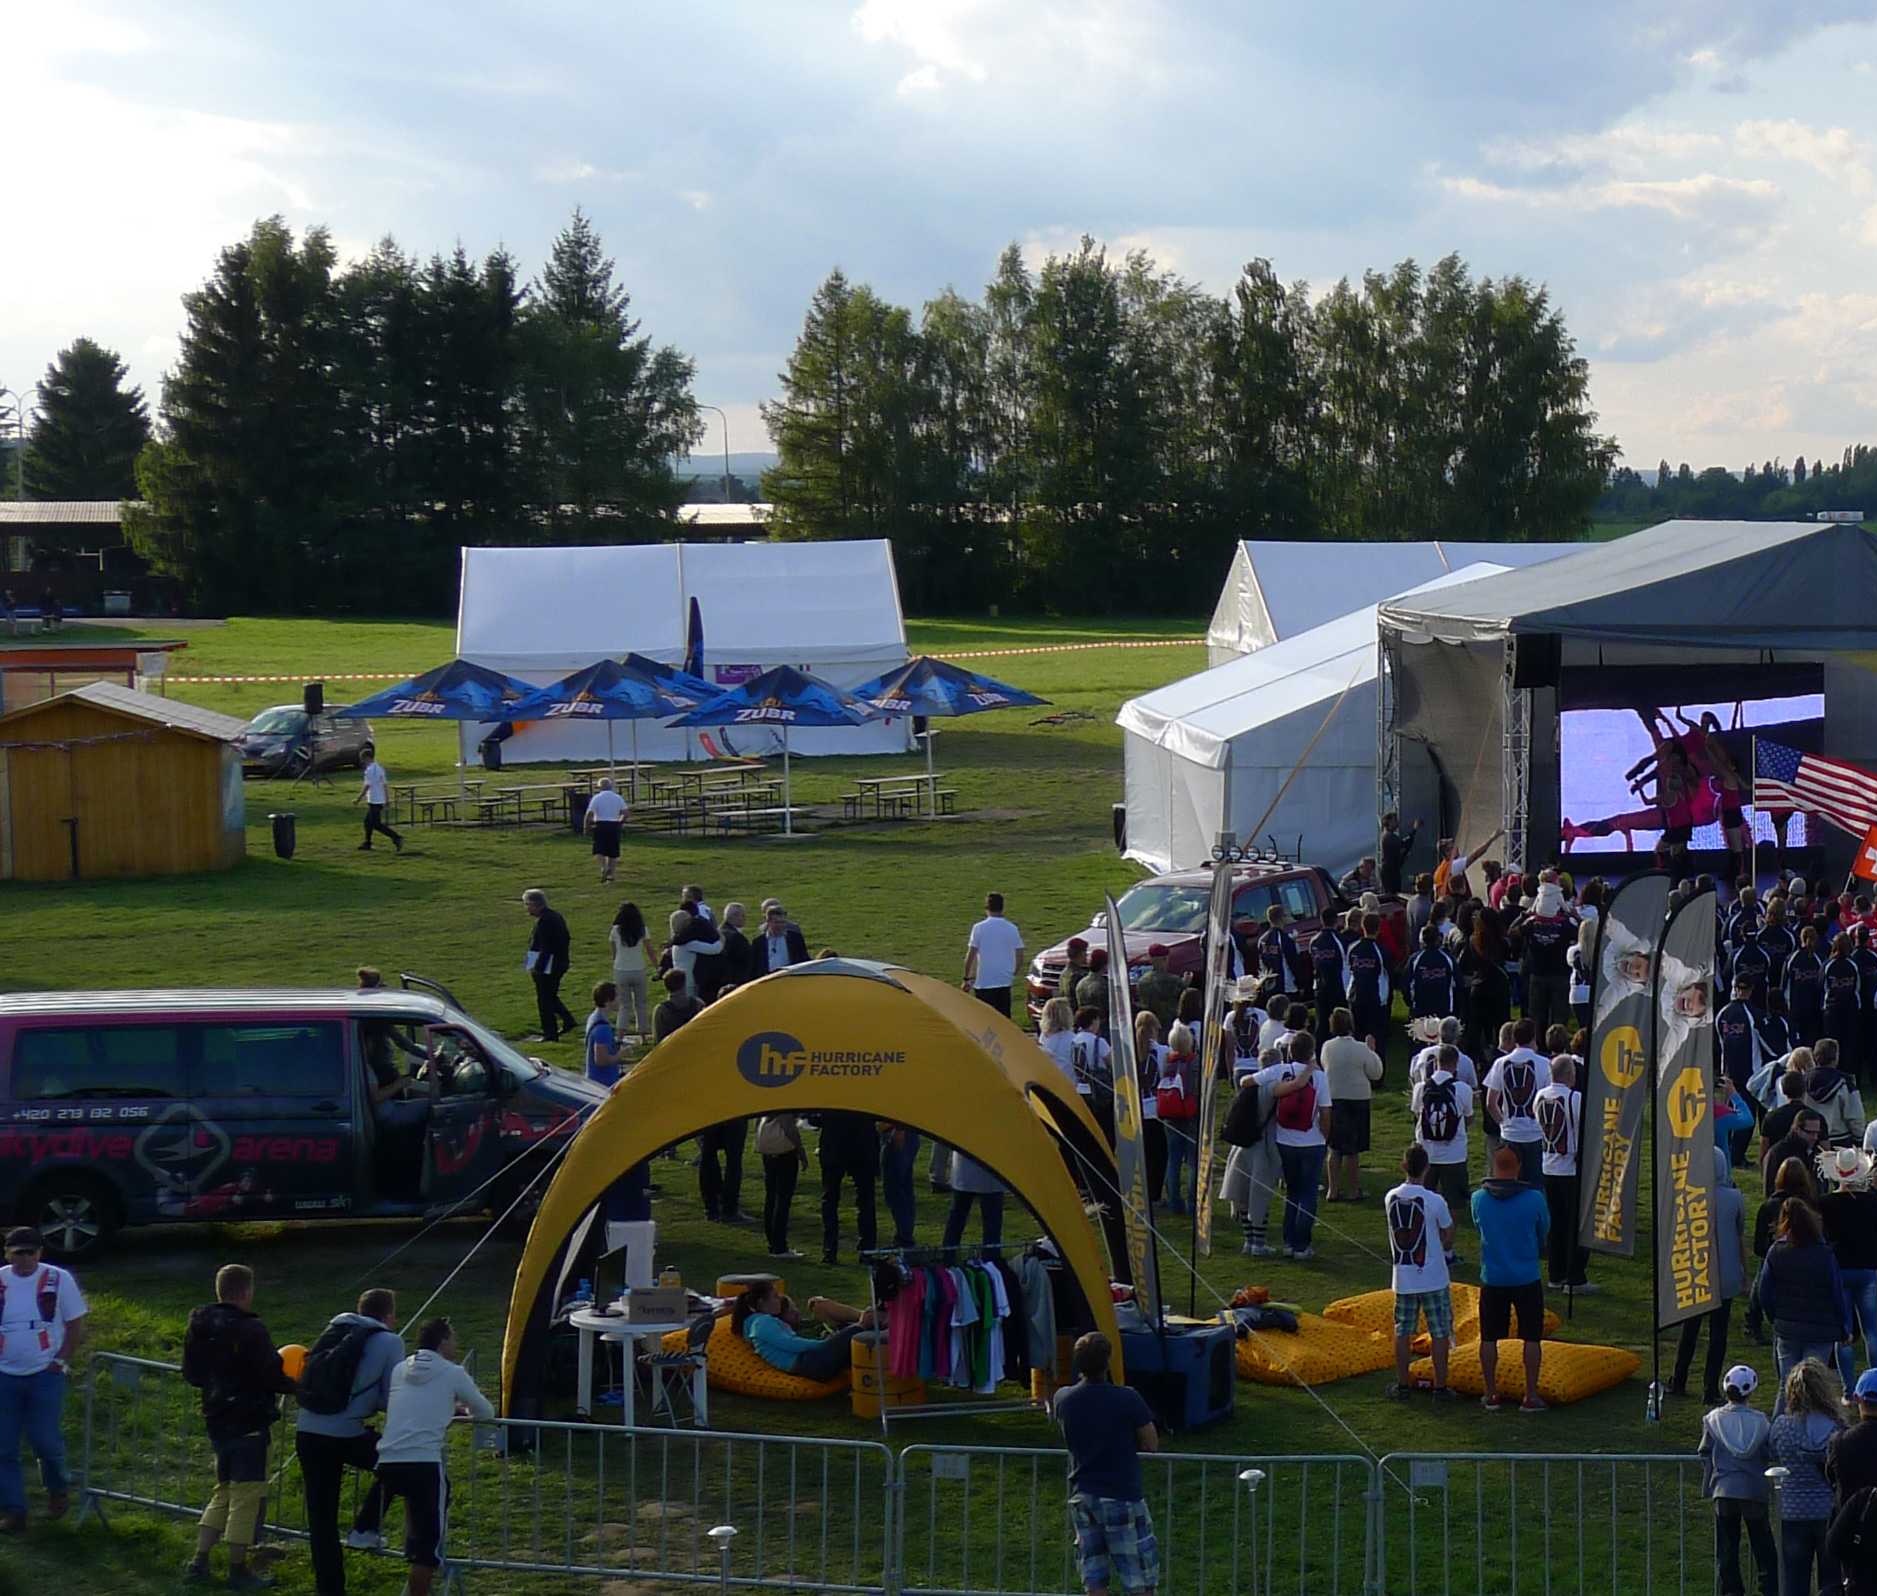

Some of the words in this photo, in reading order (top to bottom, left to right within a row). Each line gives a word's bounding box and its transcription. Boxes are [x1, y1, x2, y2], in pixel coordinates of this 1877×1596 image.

[387, 699, 446, 714] ZUBR
[544, 701, 604, 717] ZUBR
[734, 707, 796, 722] ZUBR
[810, 1051, 906, 1063] HURRICANE
[809, 1064, 884, 1077] FACTORY
[12, 1108, 50, 1120] +420
[231, 1135, 339, 1162] arena
[1686, 1183, 1713, 1305] FACTORY
